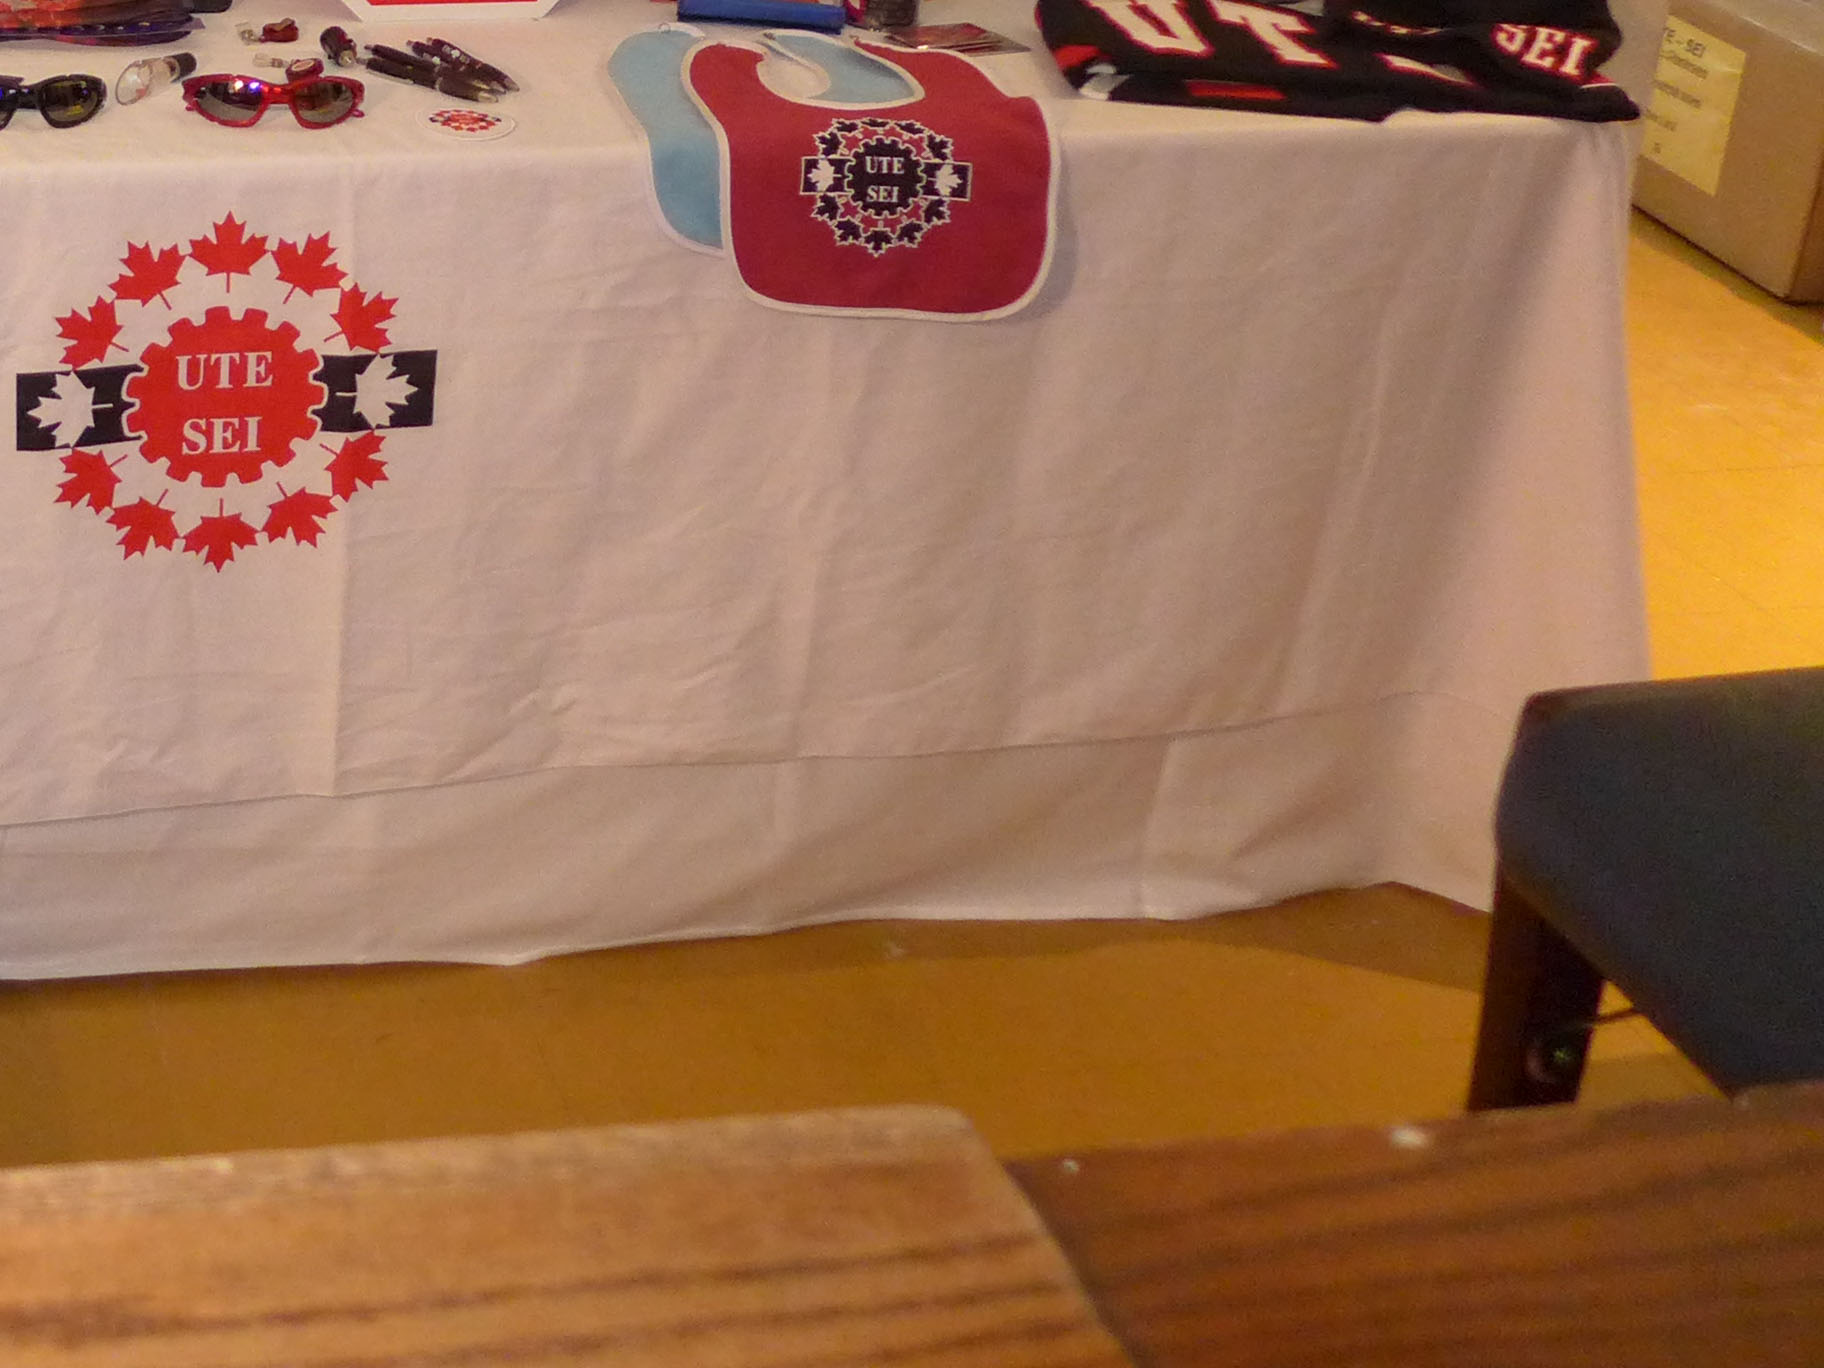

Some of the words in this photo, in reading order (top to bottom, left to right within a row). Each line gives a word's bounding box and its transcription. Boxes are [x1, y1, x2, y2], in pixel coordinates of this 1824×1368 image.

[865, 155, 905, 174] UTE
[866, 185, 900, 203] SEI
[175, 350, 273, 390] UTE
[181, 416, 263, 455] SEI
